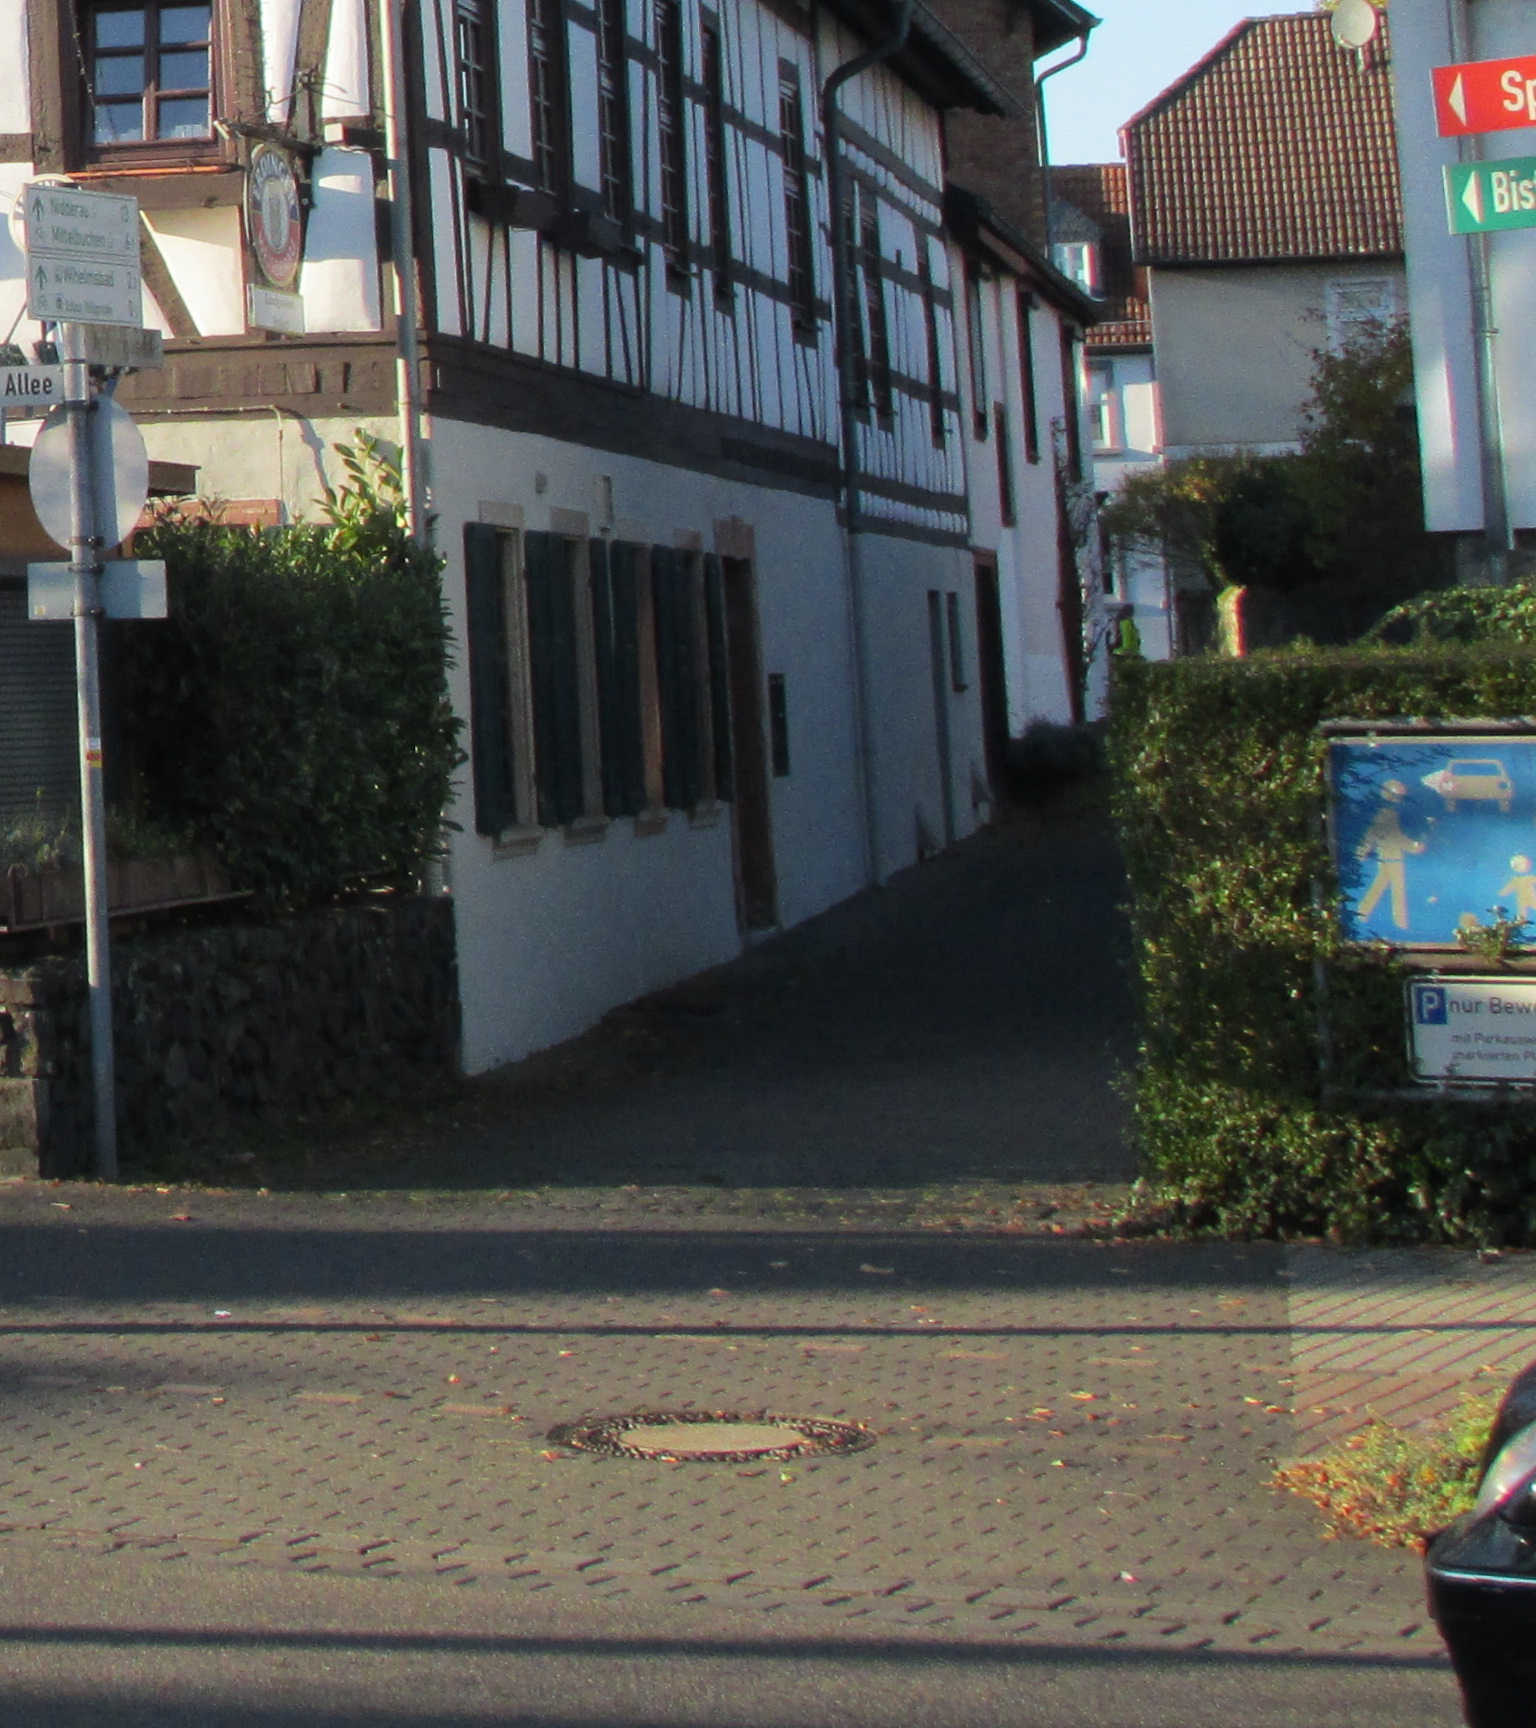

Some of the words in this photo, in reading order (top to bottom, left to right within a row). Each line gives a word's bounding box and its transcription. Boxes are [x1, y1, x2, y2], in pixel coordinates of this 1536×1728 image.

[1490, 169, 1536, 213] Bis
[4, 372, 53, 397] Allee
[1449, 999, 1483, 1014] nur
